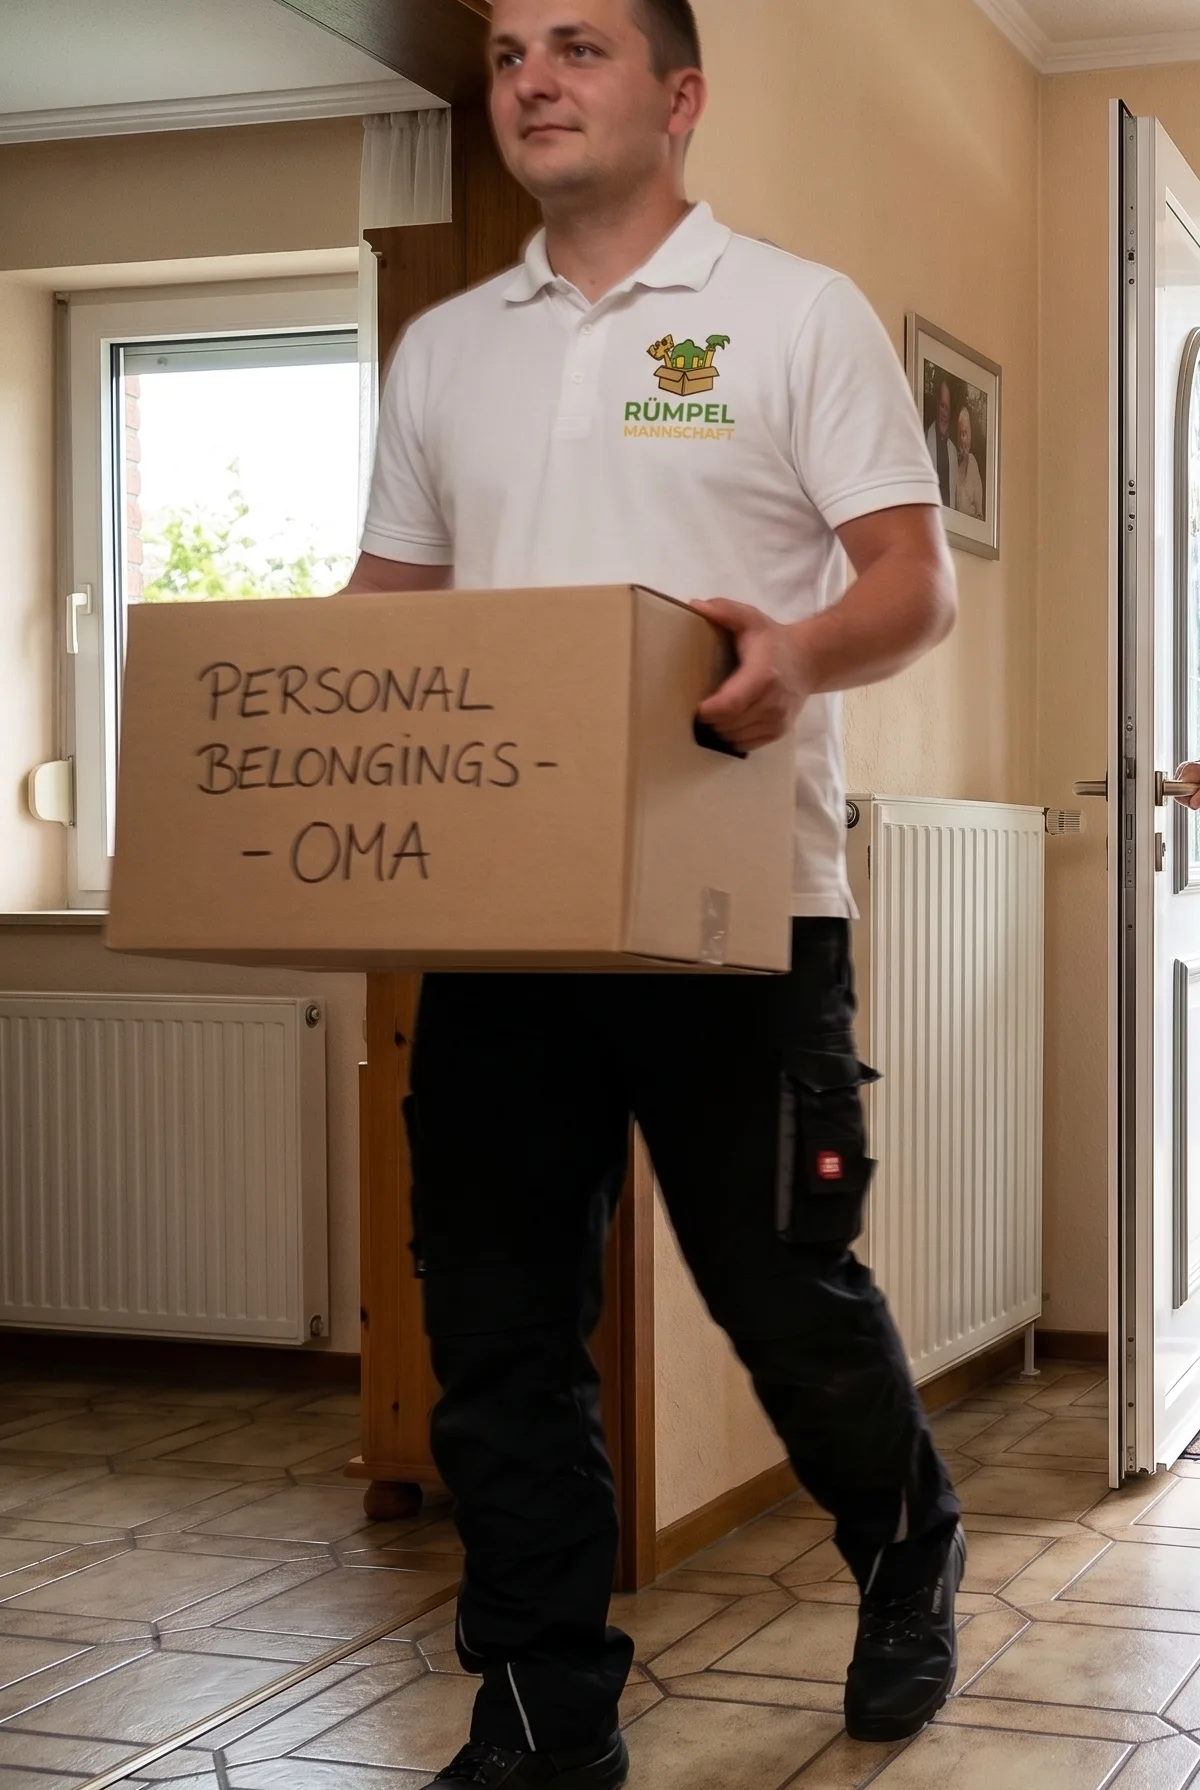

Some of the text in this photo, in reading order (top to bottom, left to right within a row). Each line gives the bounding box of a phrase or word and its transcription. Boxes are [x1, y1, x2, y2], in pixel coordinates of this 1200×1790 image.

[624, 397, 735, 424] RÜMPEL
[623, 424, 735, 441] MANNSCHAFT
[198, 661, 494, 721] PERSONAL
